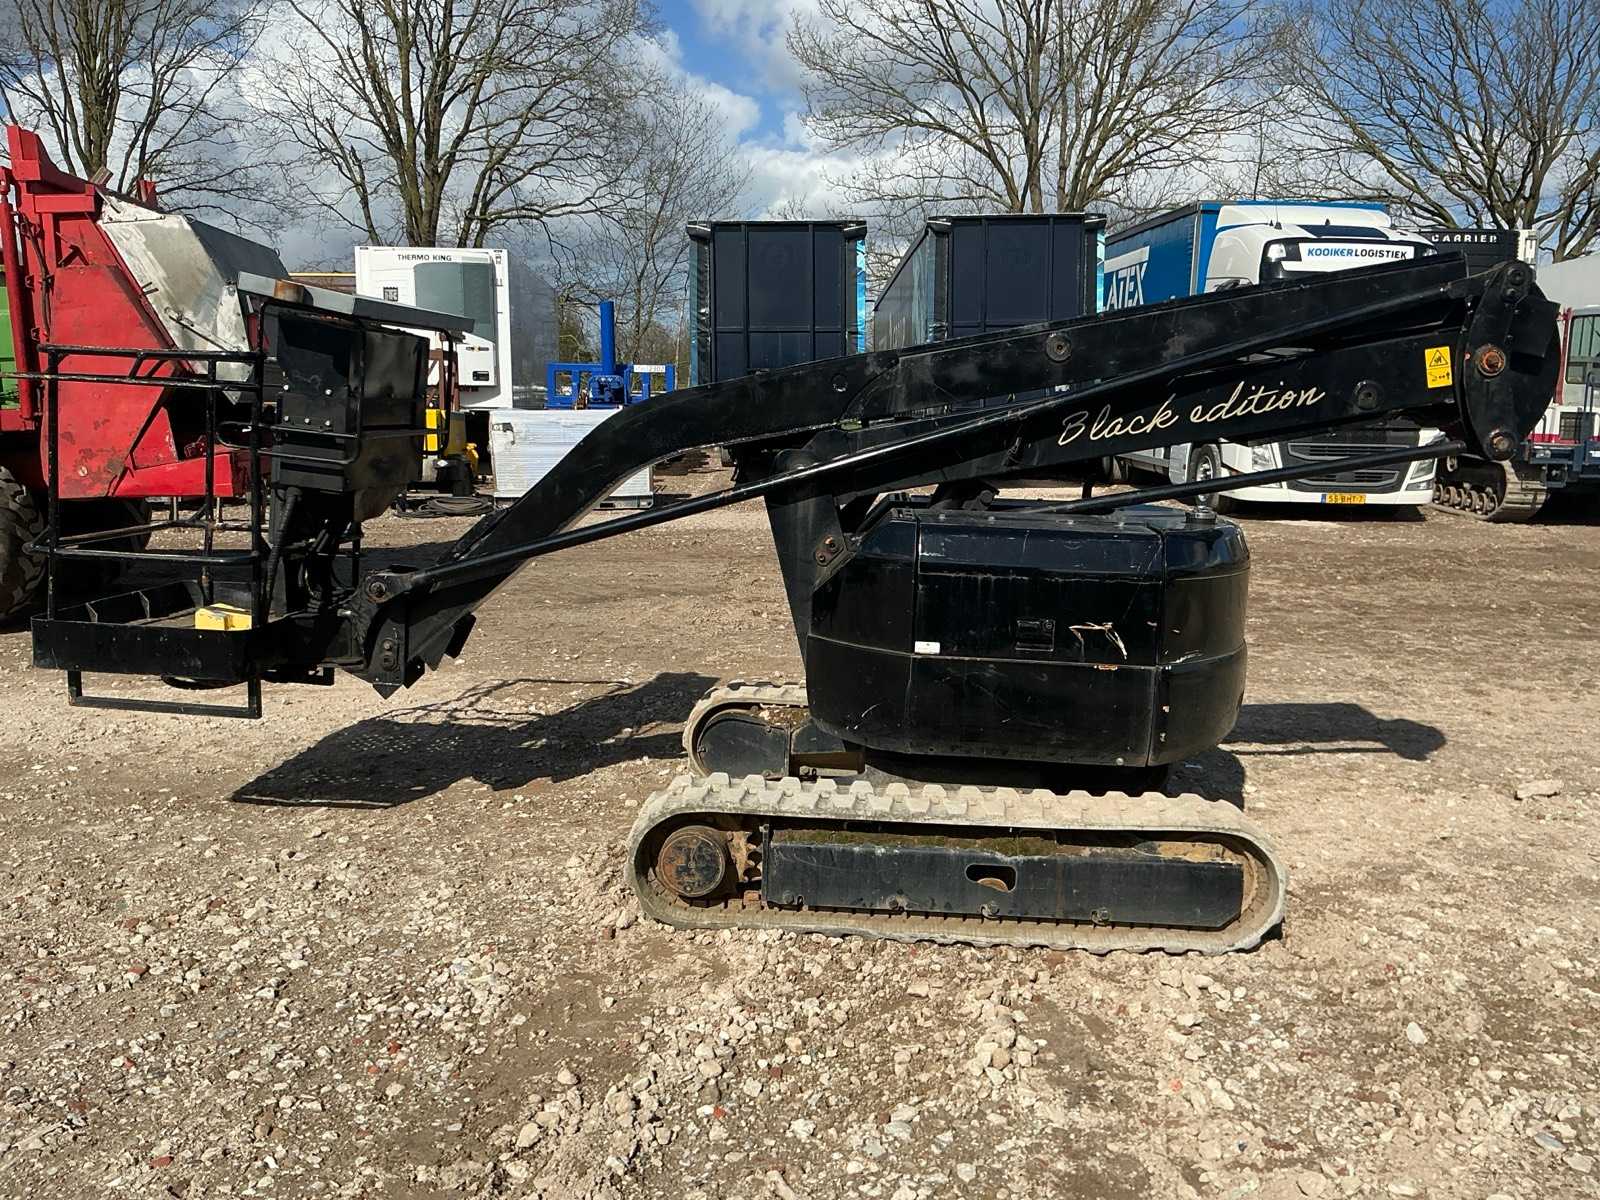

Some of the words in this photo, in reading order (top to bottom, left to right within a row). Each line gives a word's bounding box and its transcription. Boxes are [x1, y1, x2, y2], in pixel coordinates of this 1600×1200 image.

[1431, 233, 1498, 243] CARRIER
[397, 254, 430, 262] THERMO
[432, 254, 452, 262] KING
[1058, 393, 1179, 446] Black
[1189, 380, 1326, 423] edition
